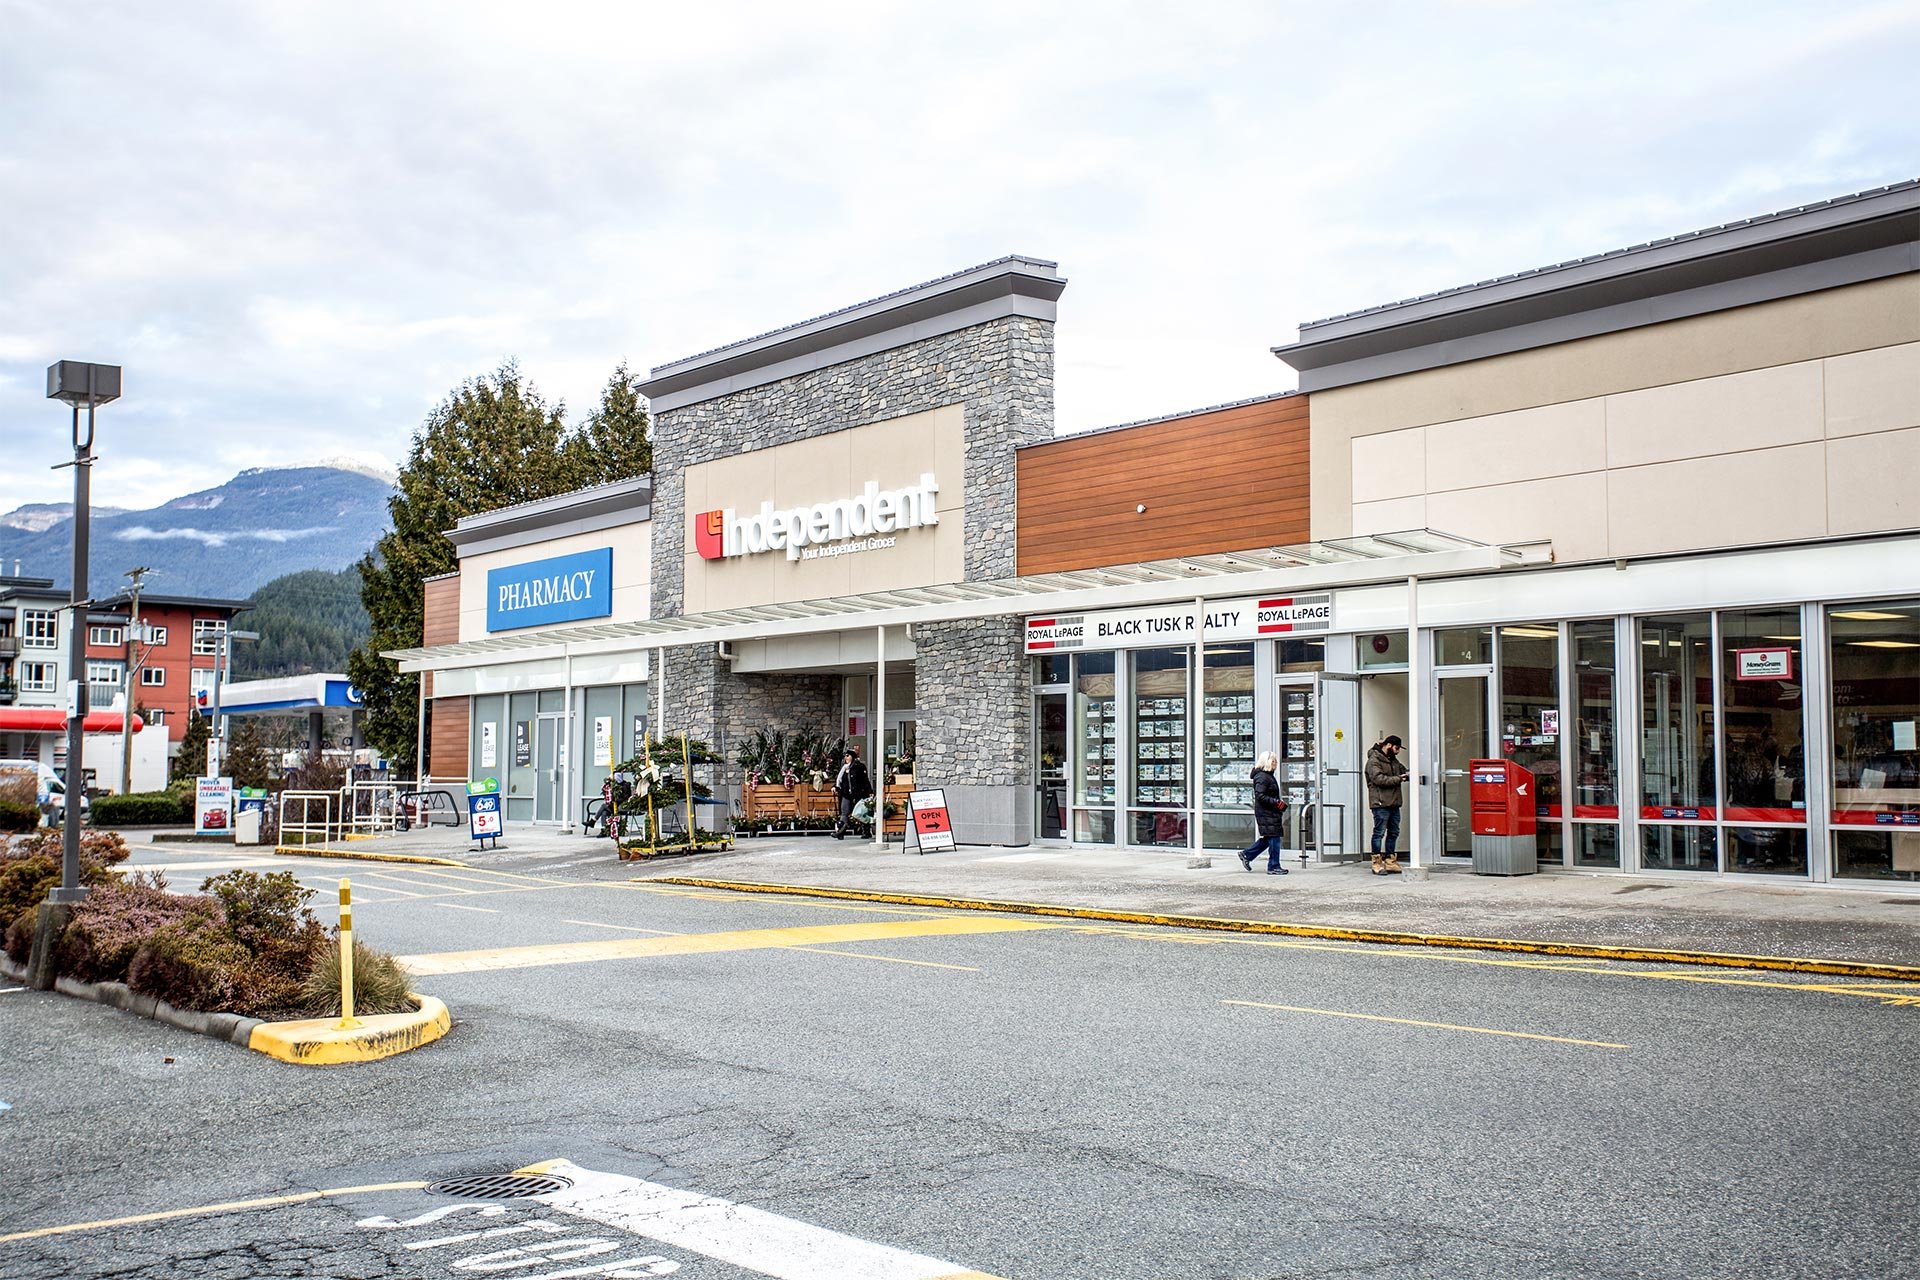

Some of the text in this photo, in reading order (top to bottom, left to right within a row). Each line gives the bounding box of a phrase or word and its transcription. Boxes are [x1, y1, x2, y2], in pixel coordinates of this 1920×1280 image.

[722, 473, 939, 562] Independent
[801, 535, 897, 560] Your Independent Grocer
[498, 569, 596, 613] PHARMACY
[1098, 611, 1240, 637] BLACK TUSK RALTY
[1257, 609, 1290, 622] ROYAL
[1027, 628, 1053, 640] ROYAL
[921, 811, 941, 820] OPEN
